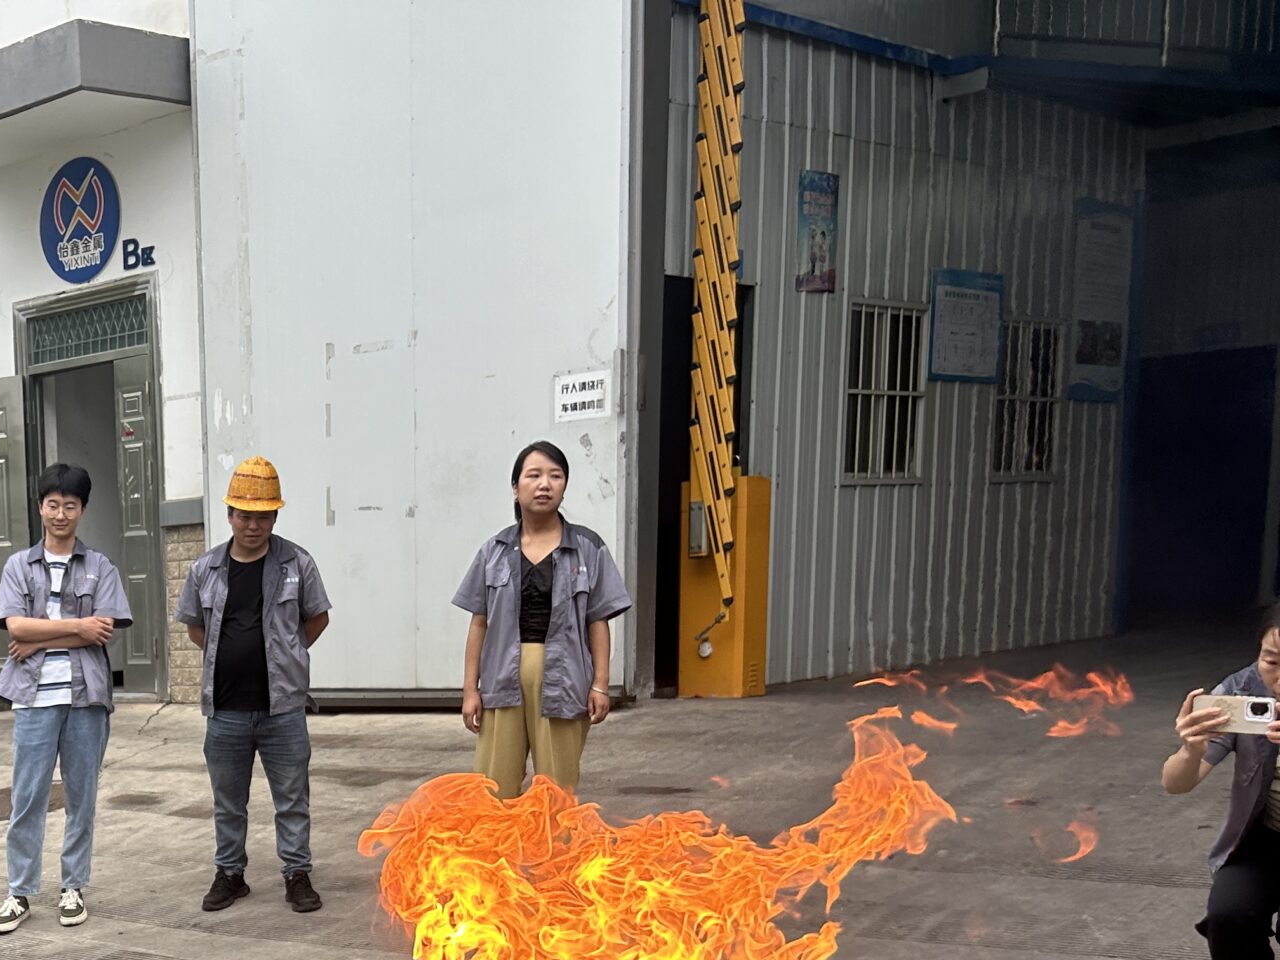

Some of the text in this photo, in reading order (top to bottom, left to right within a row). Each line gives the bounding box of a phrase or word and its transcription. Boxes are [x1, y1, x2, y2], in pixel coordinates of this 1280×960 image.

[58, 234, 104, 259] 怡鑫金属
[561, 379, 605, 395] 行人请绕行
